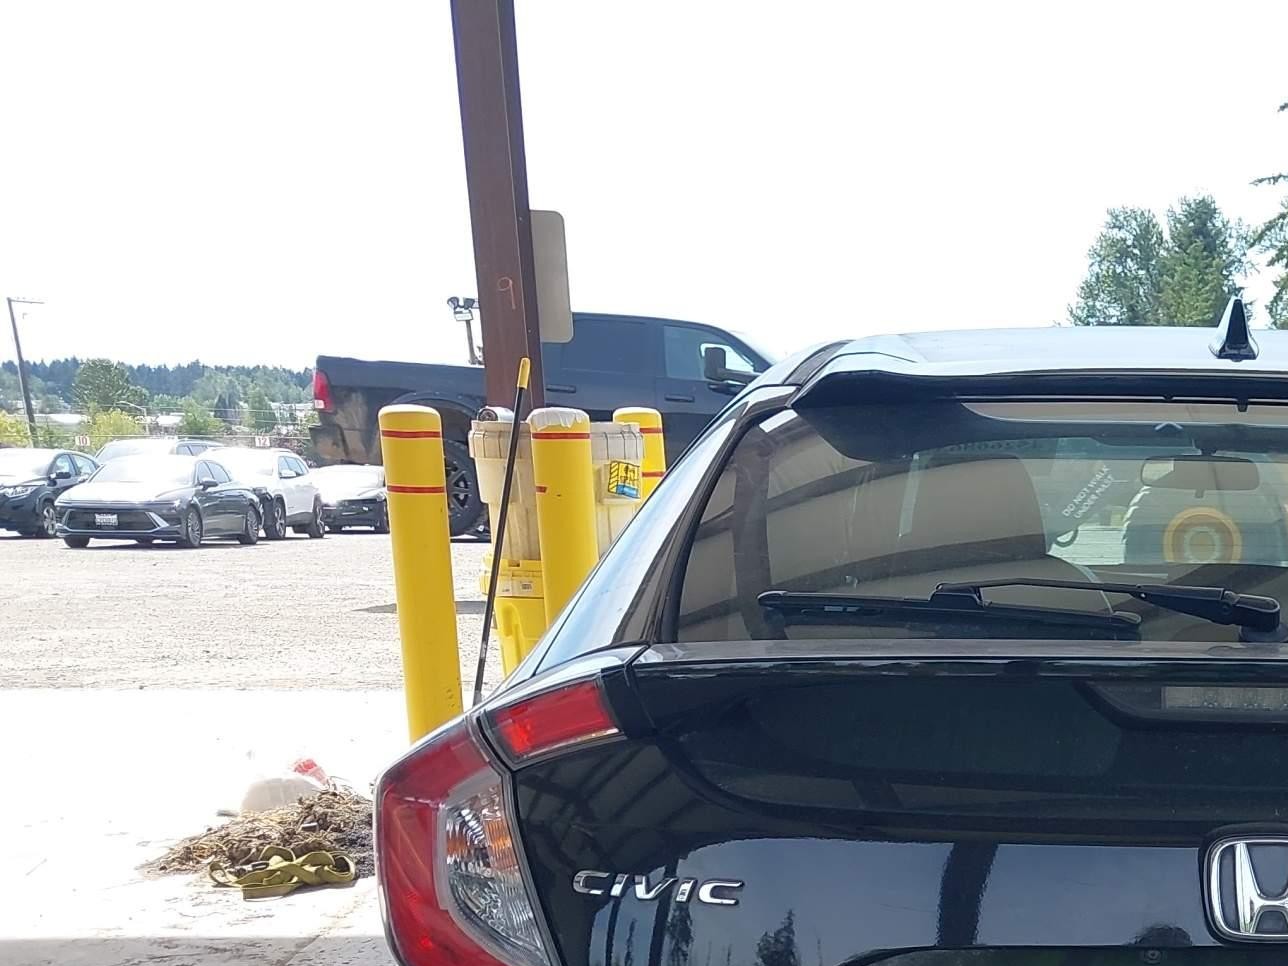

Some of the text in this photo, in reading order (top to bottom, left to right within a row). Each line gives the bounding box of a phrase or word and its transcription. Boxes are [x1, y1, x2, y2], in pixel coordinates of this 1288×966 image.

[497, 276, 516, 310] 9
[257, 437, 268, 446] 12
[1062, 503, 1076, 517] DO
[1073, 487, 1090, 504] NOT
[573, 870, 744, 905] CIVIC
